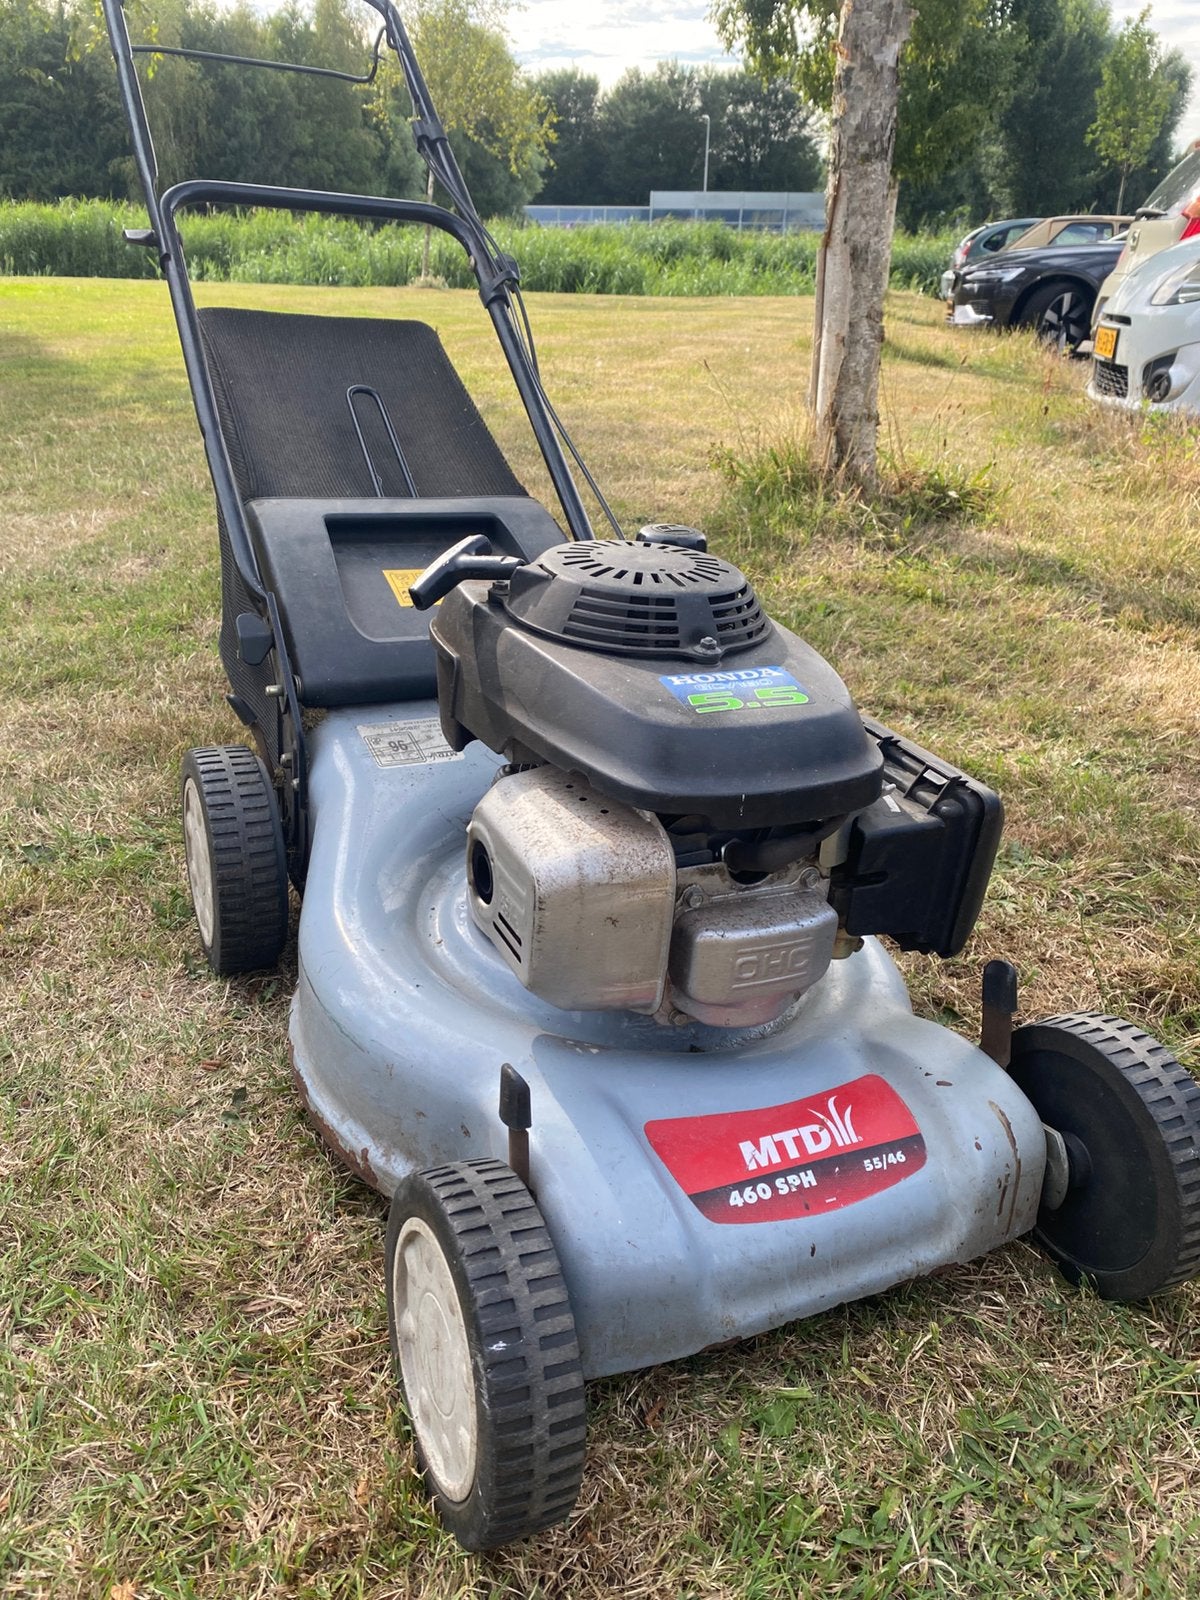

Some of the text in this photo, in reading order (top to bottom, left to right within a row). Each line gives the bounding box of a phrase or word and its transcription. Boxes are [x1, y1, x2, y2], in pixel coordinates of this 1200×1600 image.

[667, 667, 784, 686] HONDA
[687, 685, 810, 714] 5.5
[388, 740, 409, 752] 96
[735, 945, 811, 979] OHC
[738, 1123, 832, 1171] MTD
[728, 1150, 907, 1208] 460 SPH 55/46
